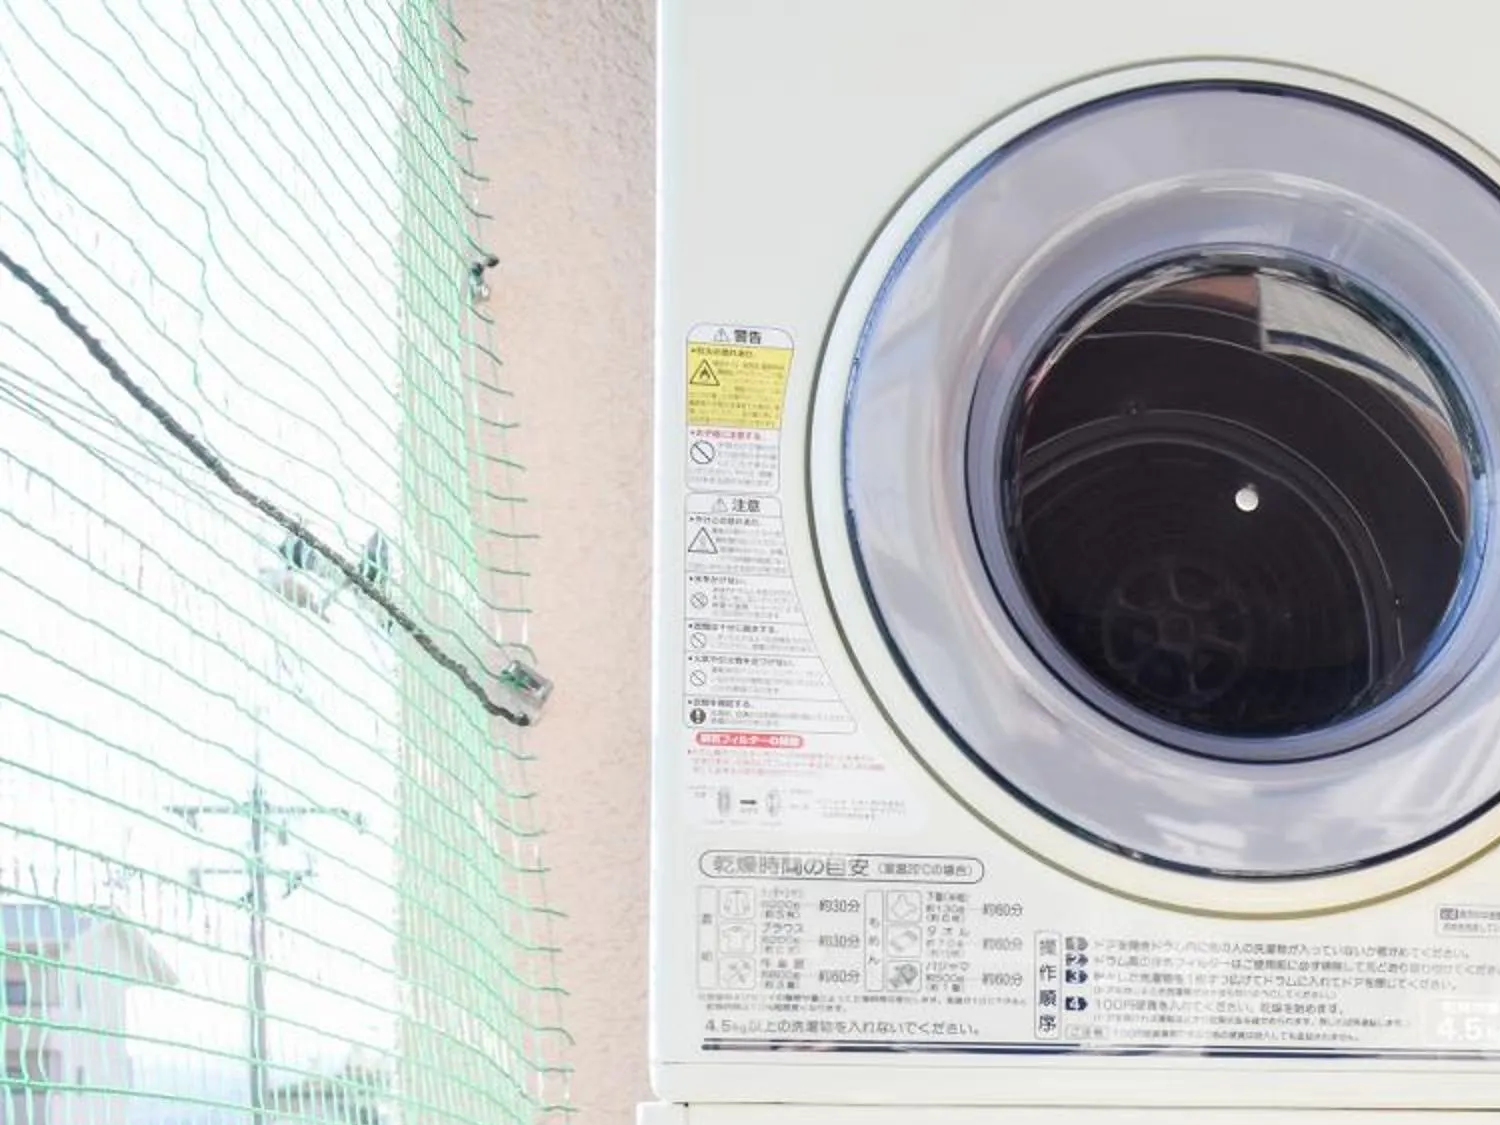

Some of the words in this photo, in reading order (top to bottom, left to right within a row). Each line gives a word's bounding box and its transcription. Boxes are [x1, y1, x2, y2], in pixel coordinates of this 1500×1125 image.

[733, 329, 762, 345] 警告
[713, 855, 869, 878] 乾燥時間の目安
